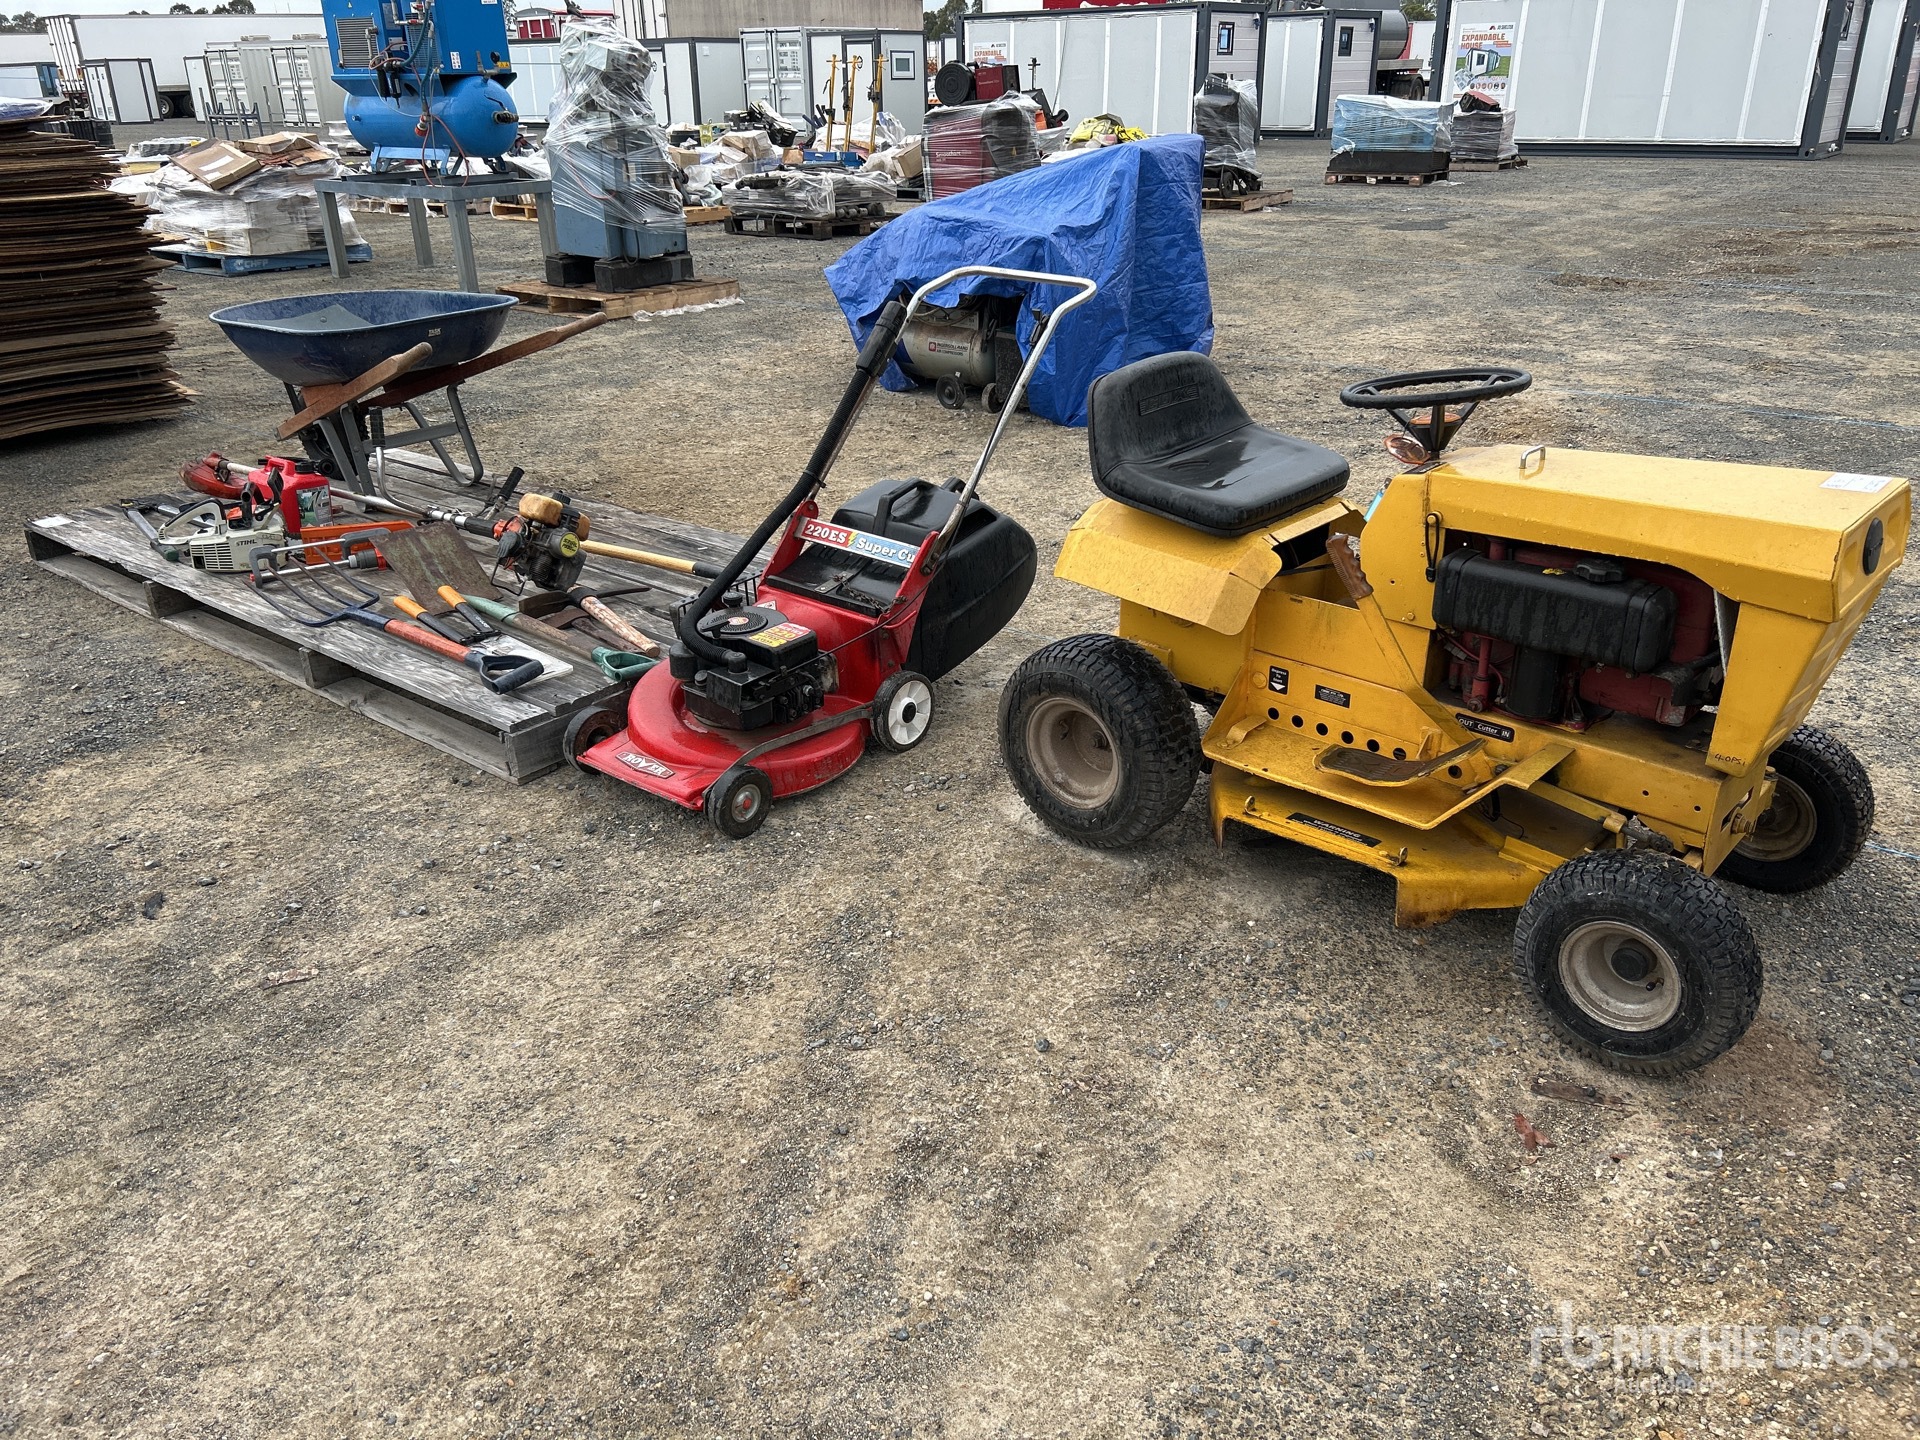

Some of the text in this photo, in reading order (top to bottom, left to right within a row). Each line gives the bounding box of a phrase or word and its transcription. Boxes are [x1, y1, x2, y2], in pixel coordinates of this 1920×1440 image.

[1460, 42, 1482, 50] HOUSE
[1461, 33, 1505, 41] EXPANDABLE
[236, 539, 258, 547] STIHL
[804, 523, 848, 544] 220ES
[856, 537, 896, 558] Super
[1458, 718, 1510, 738] OUT Cutter IN
[622, 753, 667, 775] ROVER
[1313, 819, 1362, 838] WARNING
